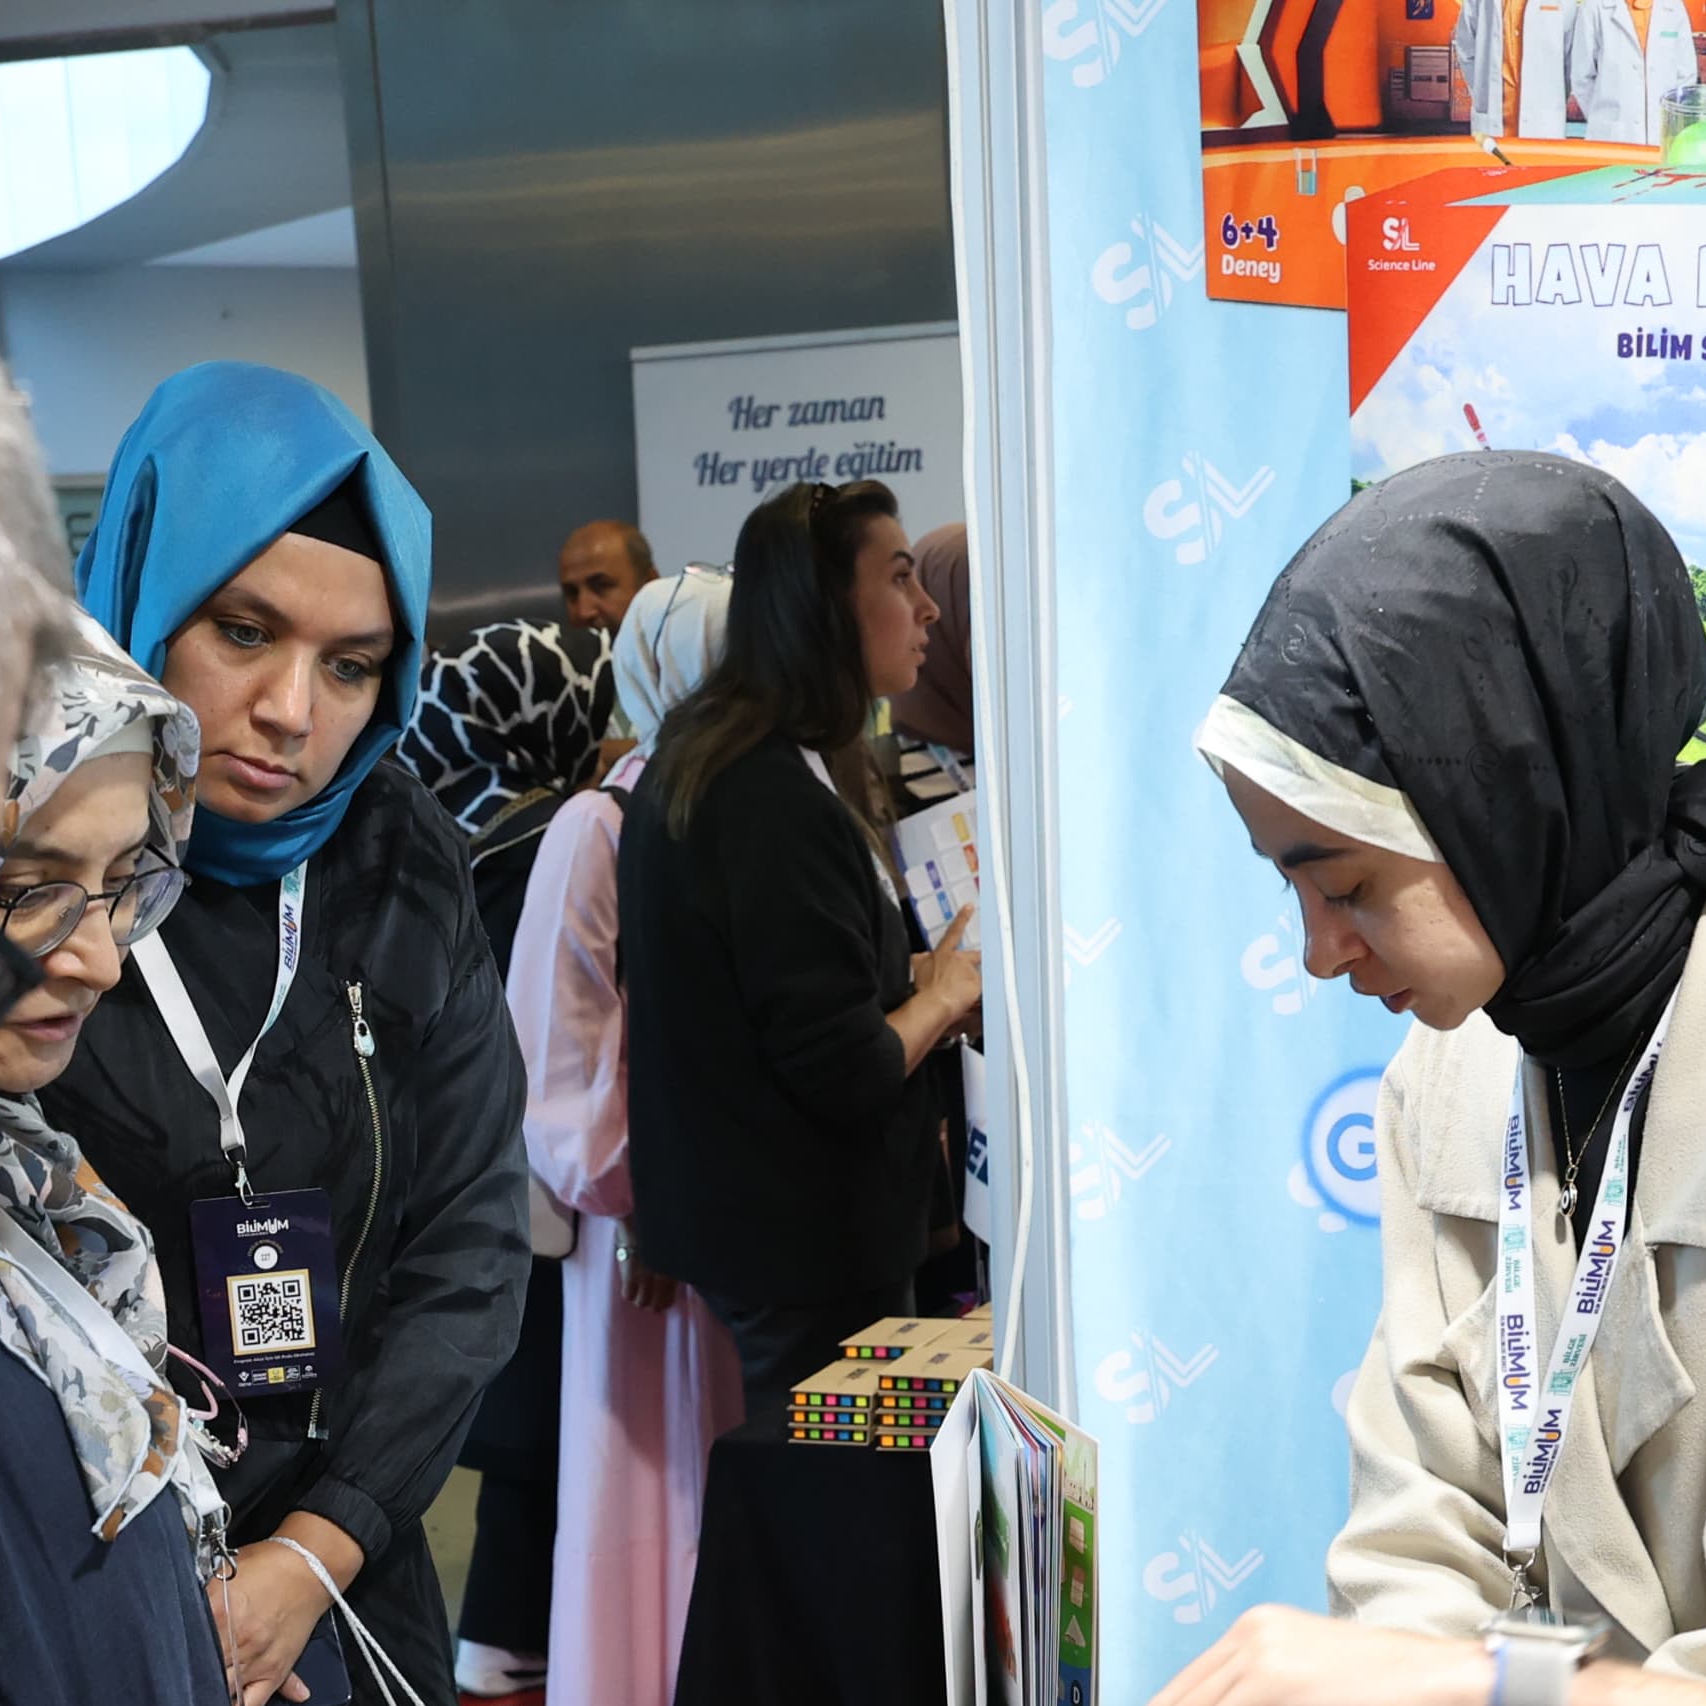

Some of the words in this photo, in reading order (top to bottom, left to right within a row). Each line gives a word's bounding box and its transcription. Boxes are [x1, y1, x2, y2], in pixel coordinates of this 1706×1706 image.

[1221, 213, 1279, 250] 6+4
[1221, 254, 1282, 284] Deney
[1367, 258, 1410, 271] Science
[1412, 259, 1436, 271] Line
[1491, 242, 1672, 306] HAVA
[1617, 328, 1692, 361] BİLİM
[728, 395, 782, 432] Her
[788, 395, 886, 428] zaman
[695, 449, 747, 489] Her
[752, 446, 828, 491] yerde
[835, 441, 923, 481] eğitim
[236, 1217, 290, 1236] BİLİMUM
[1576, 1220, 1616, 1315] BİLİMUM
[1501, 1314, 1532, 1411] BİLİMUM
[1523, 1408, 1563, 1496] BİLİMUM
